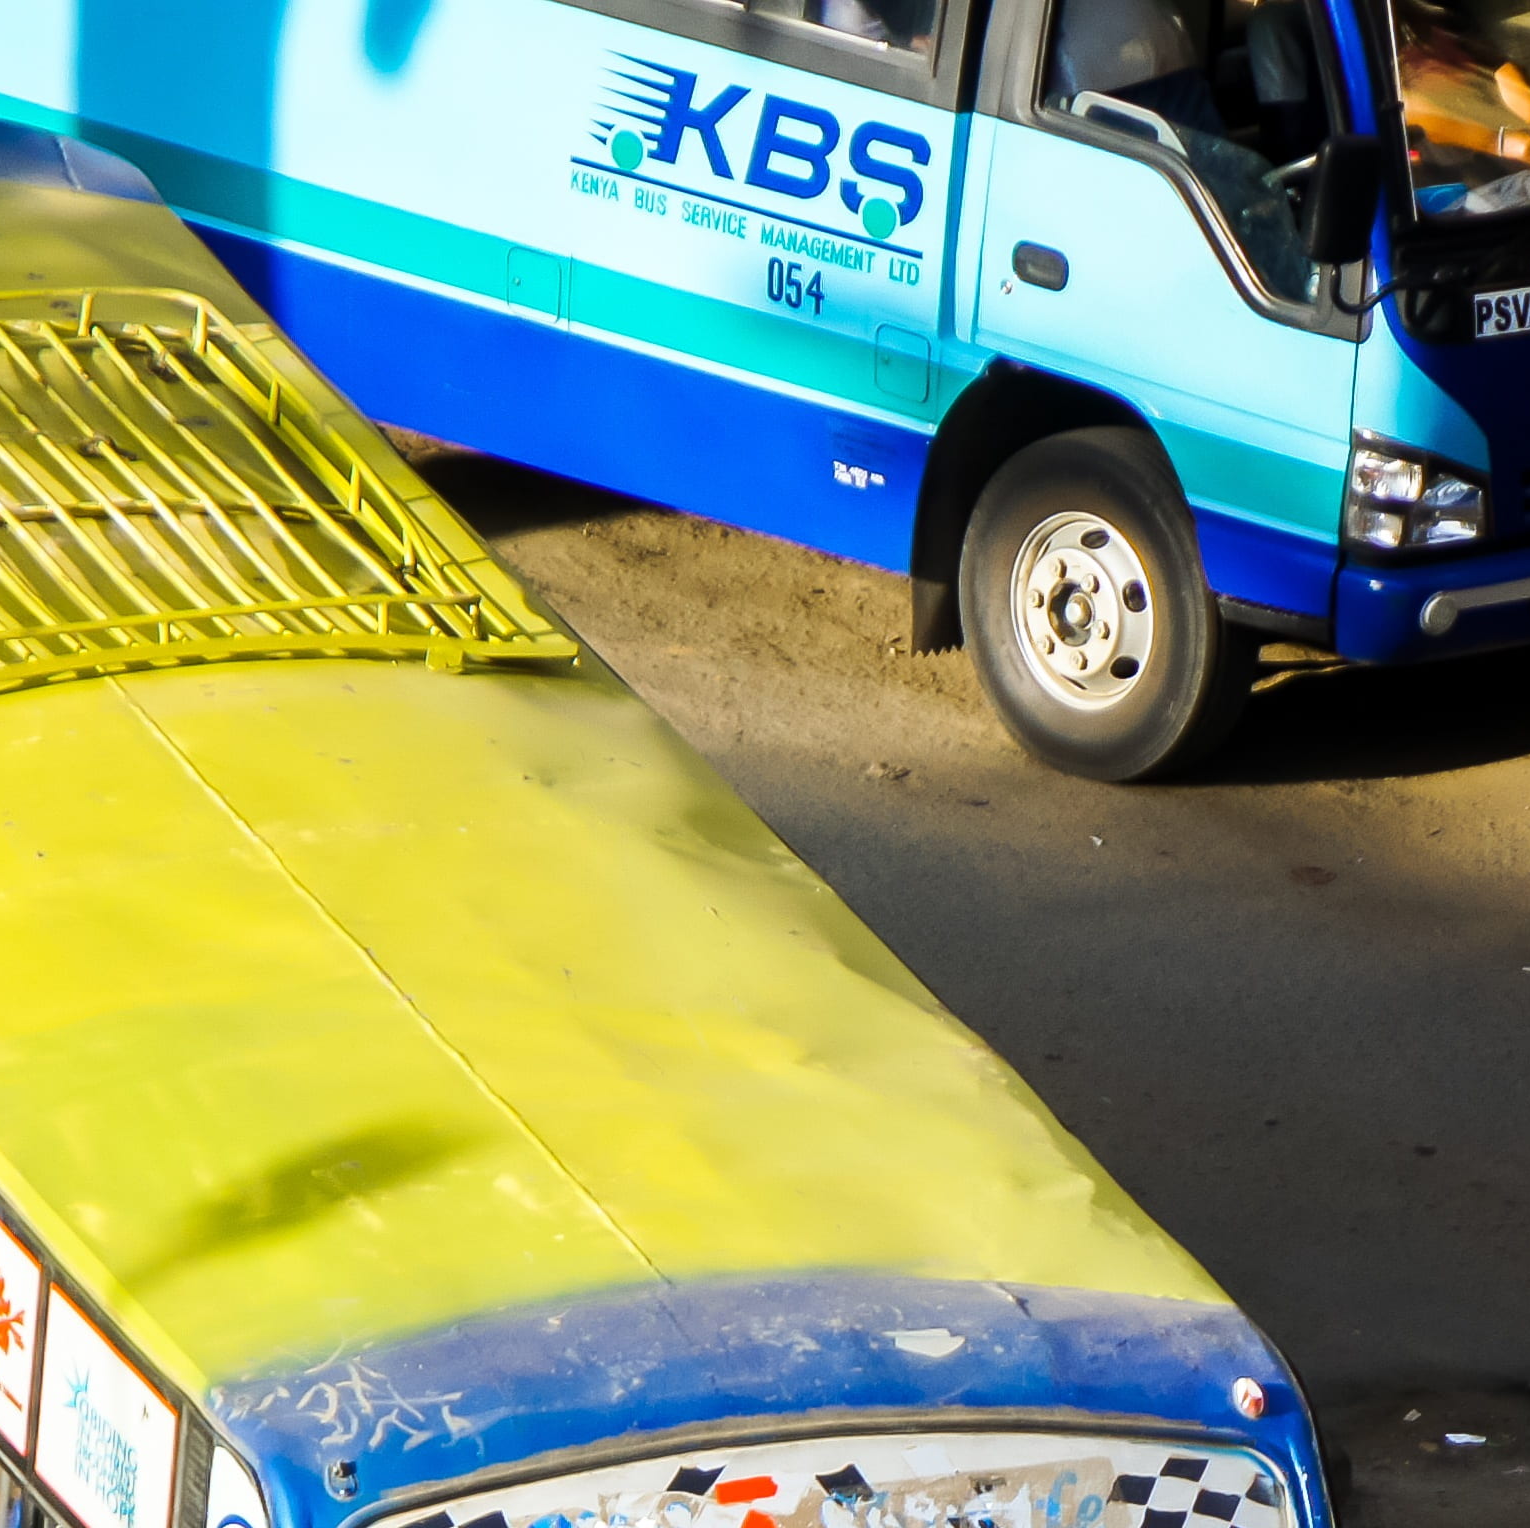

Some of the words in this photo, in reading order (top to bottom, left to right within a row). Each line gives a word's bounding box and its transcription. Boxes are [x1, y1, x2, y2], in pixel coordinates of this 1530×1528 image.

[609, 55, 932, 227] KBS
[571, 169, 619, 202] KENYA
[634, 187, 667, 216] BUS
[682, 201, 747, 239] SERVICE
[761, 222, 876, 274] MANAGEMENT
[889, 257, 921, 286] LTD
[767, 256, 825, 316] 054
